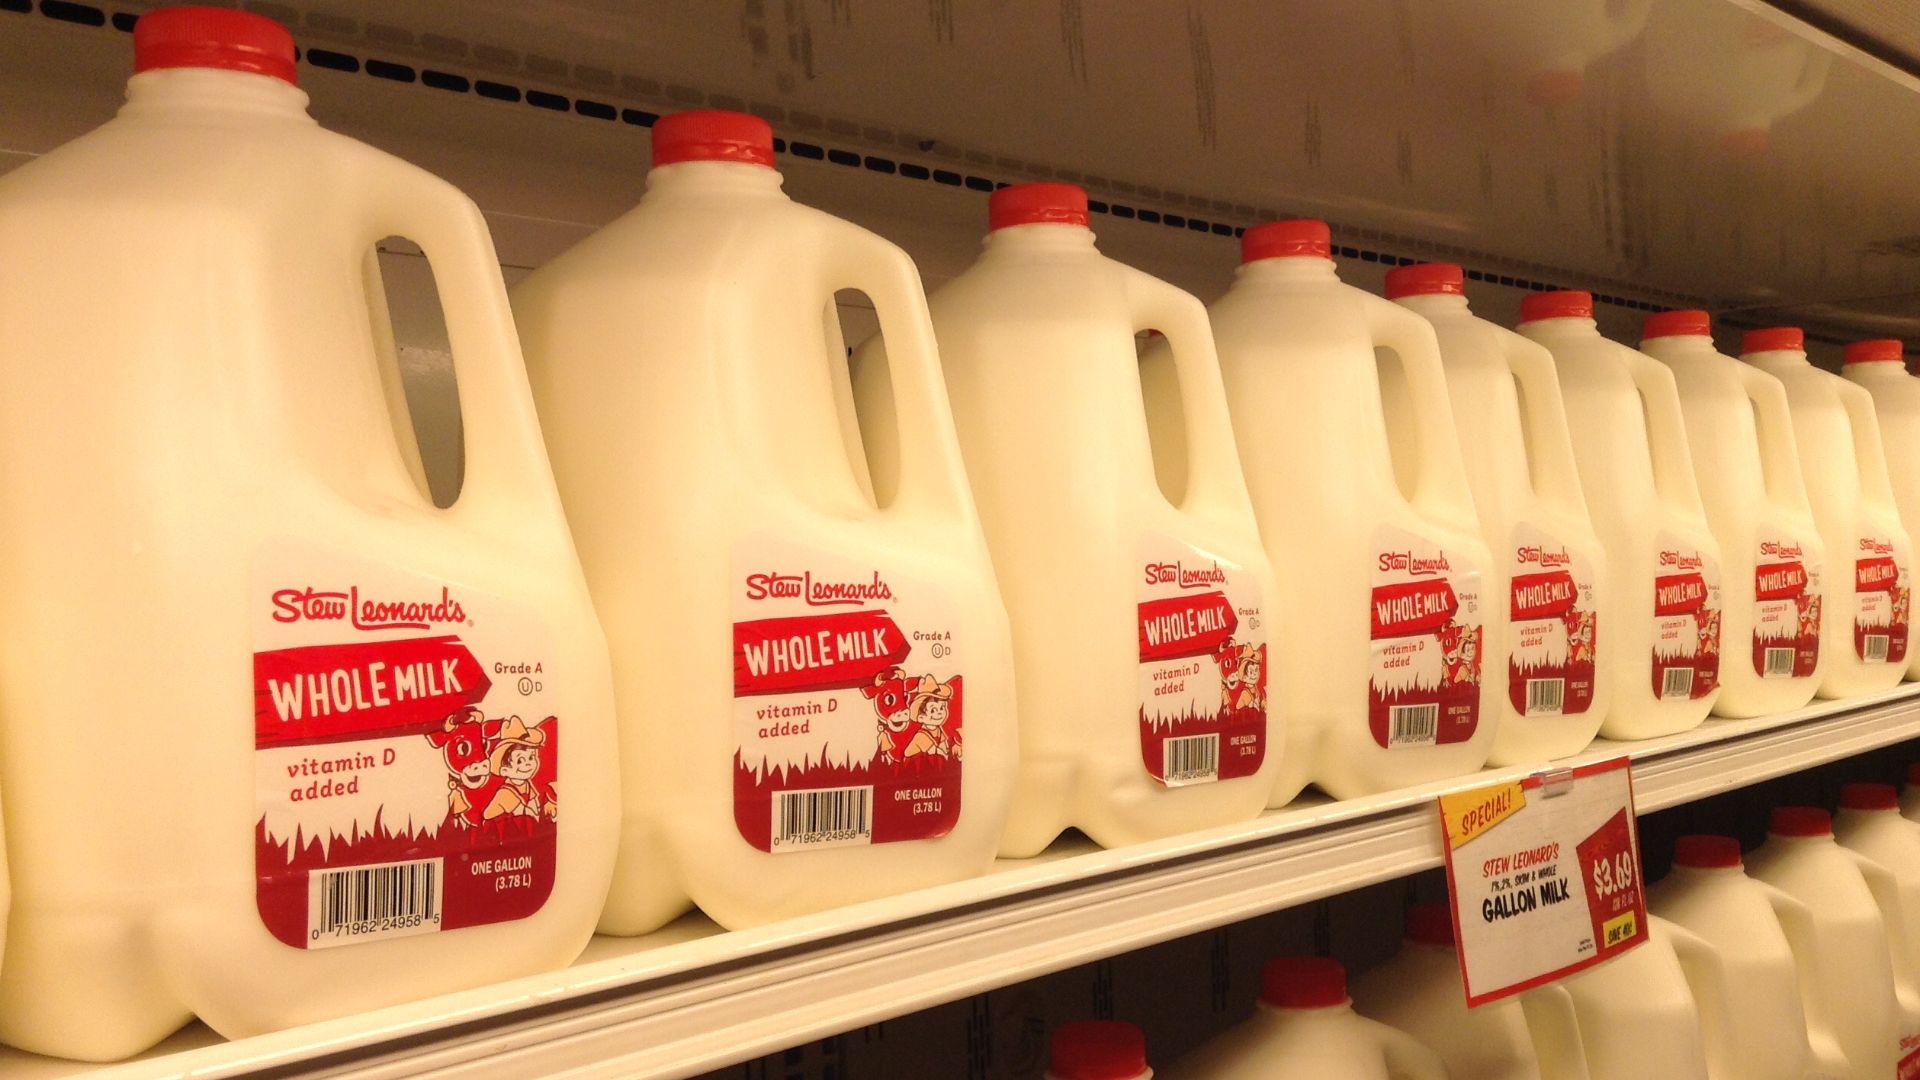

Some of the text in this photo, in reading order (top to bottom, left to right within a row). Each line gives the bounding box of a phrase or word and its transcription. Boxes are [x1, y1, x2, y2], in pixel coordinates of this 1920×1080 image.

[1379, 552, 1407, 572] Stew
[1145, 560, 1226, 589] Stew Leonard's
[1759, 570, 1786, 592] WHOLE
[746, 571, 892, 606] Stew Leonard's
[1516, 581, 1571, 609] WHOLE MILK
[1659, 583, 1686, 606] WHOLE
[272, 586, 466, 630] Stew Leonard's
[1376, 591, 1449, 625] WHOLE MILK
[913, 631, 951, 641] Grade A
[1144, 605, 1227, 646] WHOLE MILK
[743, 628, 889, 677] WHOLE MILK
[1383, 645, 1417, 656] vitamin
[494, 662, 543, 675] Grade A
[1153, 663, 1200, 681] vitamin D
[1384, 656, 1410, 669] added
[269, 658, 462, 722] WHOLE MILK
[535, 681, 542, 692] D
[1154, 681, 1185, 696] added
[757, 698, 838, 720] vitamin D
[759, 720, 810, 739] added
[287, 748, 395, 778] vitamin D
[290, 777, 359, 802] added
[894, 787, 942, 801] ONE GALLON
[913, 803, 932, 815] (3.78
[1462, 788, 1512, 836] SPECIAL!
[471, 856, 532, 875] ONE GALLON
[1483, 841, 1559, 878] STEW LEONARD'S
[495, 875, 532, 891] (3.78 L)
[1594, 850, 1631, 901] $3.69
[1483, 877, 1570, 923] GALLON MILK
[312, 929, 319, 940] 0
[336, 921, 377, 937] 71962
[381, 914, 422, 931] 24958
